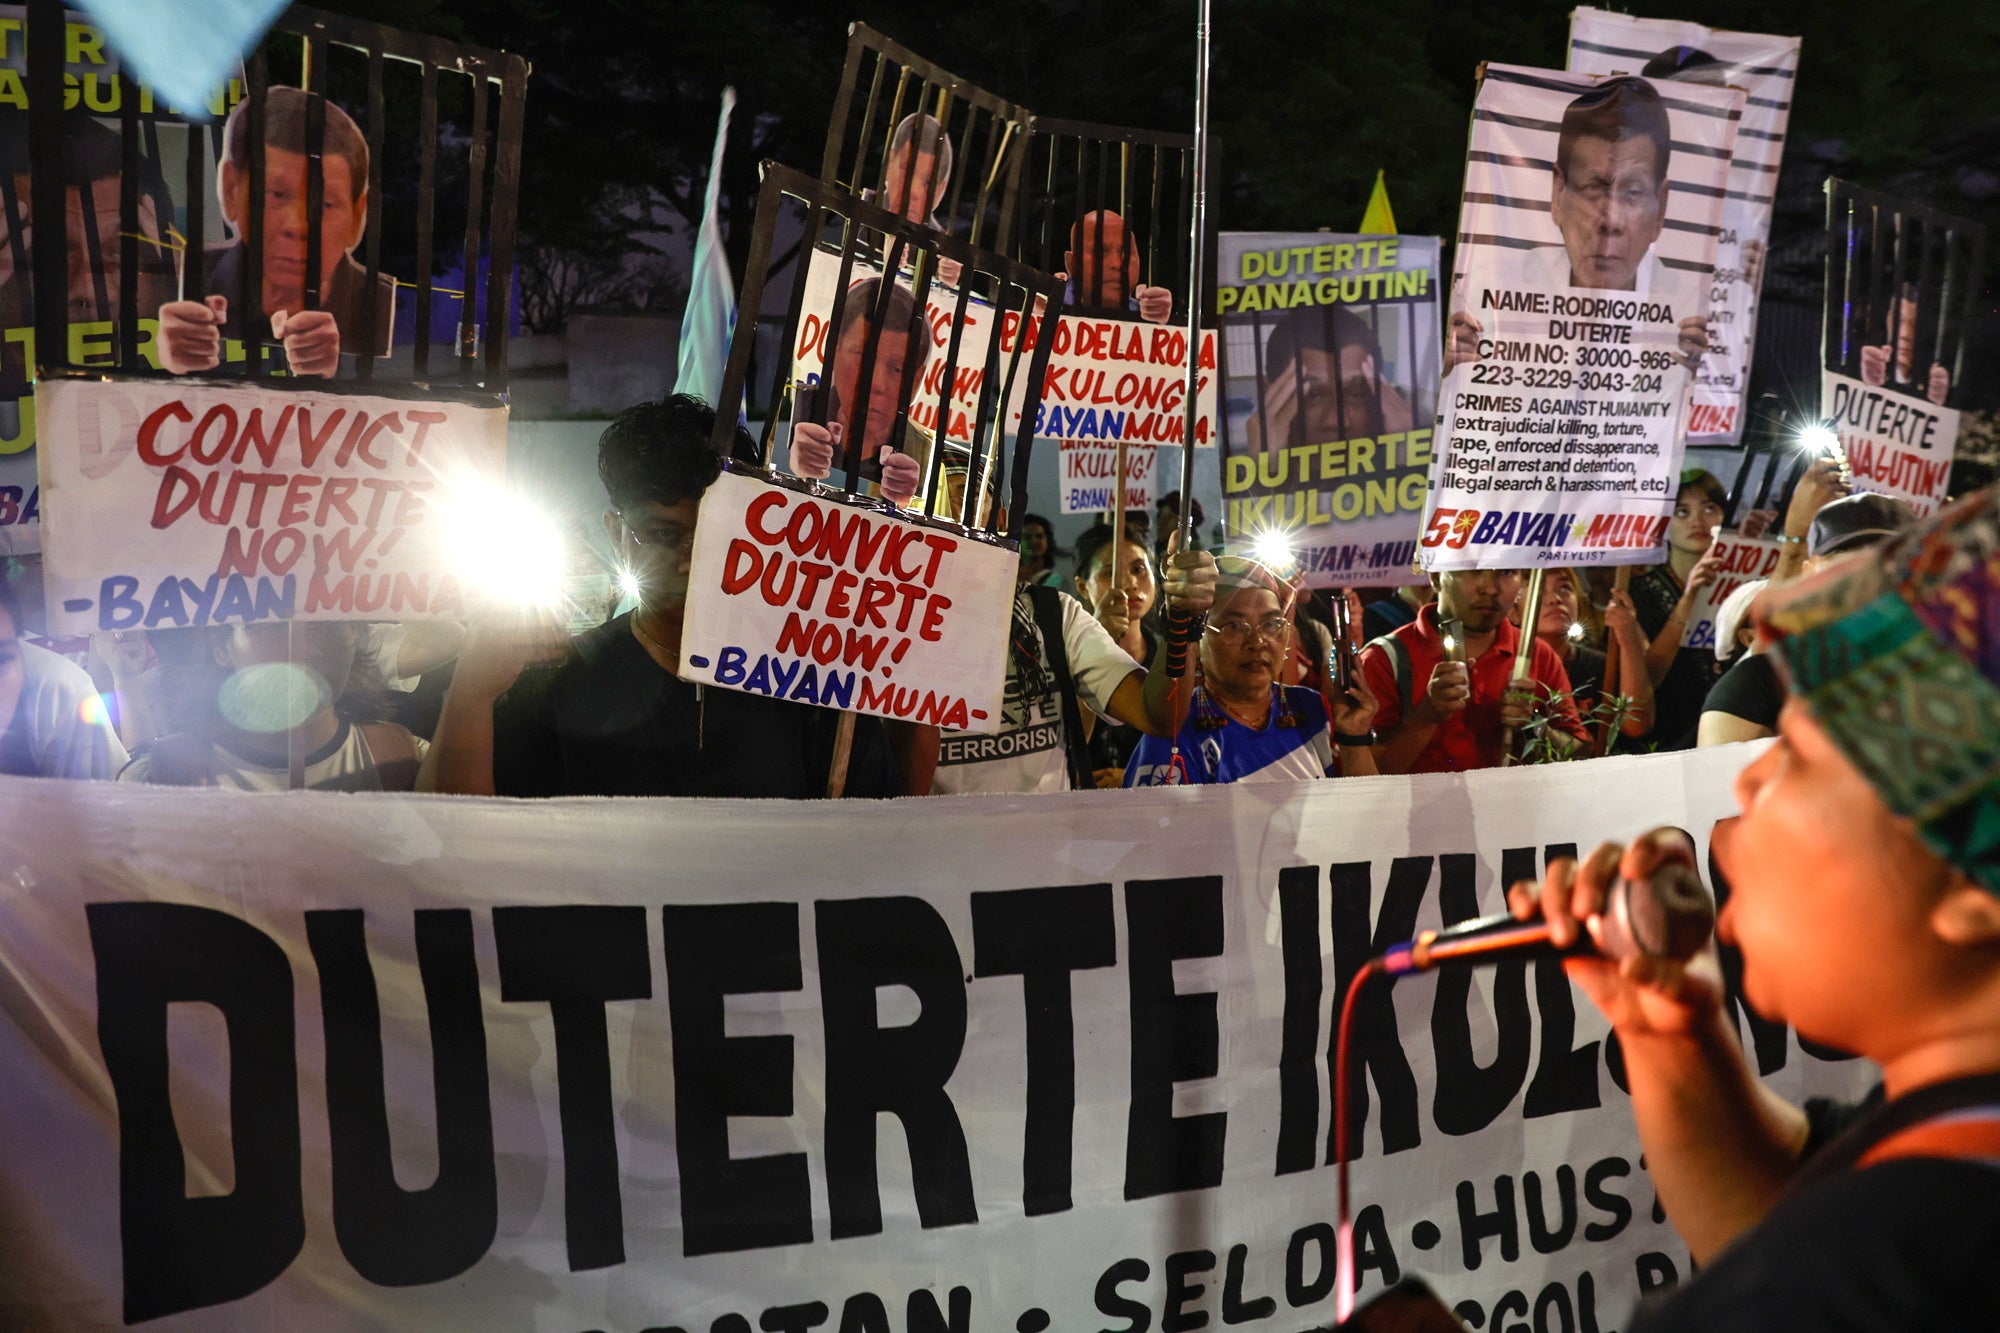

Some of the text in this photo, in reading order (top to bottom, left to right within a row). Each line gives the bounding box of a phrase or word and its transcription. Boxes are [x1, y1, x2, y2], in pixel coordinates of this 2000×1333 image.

[1241, 239, 1398, 280] DUTERTE
[1216, 268, 1428, 315] PANAGUTIN!
[1481, 289, 1674, 323] NAME: RODRIGO ROA
[1549, 320, 1632, 344] DUTERTE
[1476, 339, 1677, 371] CRIM NO: 30000-966-
[1471, 364, 1663, 393] 223-3229-3043-204
[1455, 393, 1671, 417] CRIMES AGAINST HUMANITY
[1688, 404, 1736, 433] UNA
[1833, 383, 1939, 449] DUTERTE
[137, 401, 448, 471] CONVICT
[1557, 418, 1600, 439] killing,
[1603, 422, 1648, 438] torture,
[1226, 428, 1431, 494] DUTERTE
[1446, 453, 1637, 474] illegal arrest and detention,
[1451, 437, 1660, 458] rape, enforced dissapperance,
[150, 465, 435, 530] DUTERTE
[1442, 473, 1671, 494] illegal search & harassment, etc)
[745, 490, 958, 588] CONVICT
[1420, 508, 1671, 549] 59 BAYAN MUNA
[217, 526, 406, 579] NOW!
[1537, 551, 1606, 561] PARTYLIST
[720, 538, 952, 641] DUTERTE
[1331, 570, 1389, 581] PARTYLIST
[775, 611, 911, 679] NOW!
[85, 873, 1227, 1325] DUTERTE
